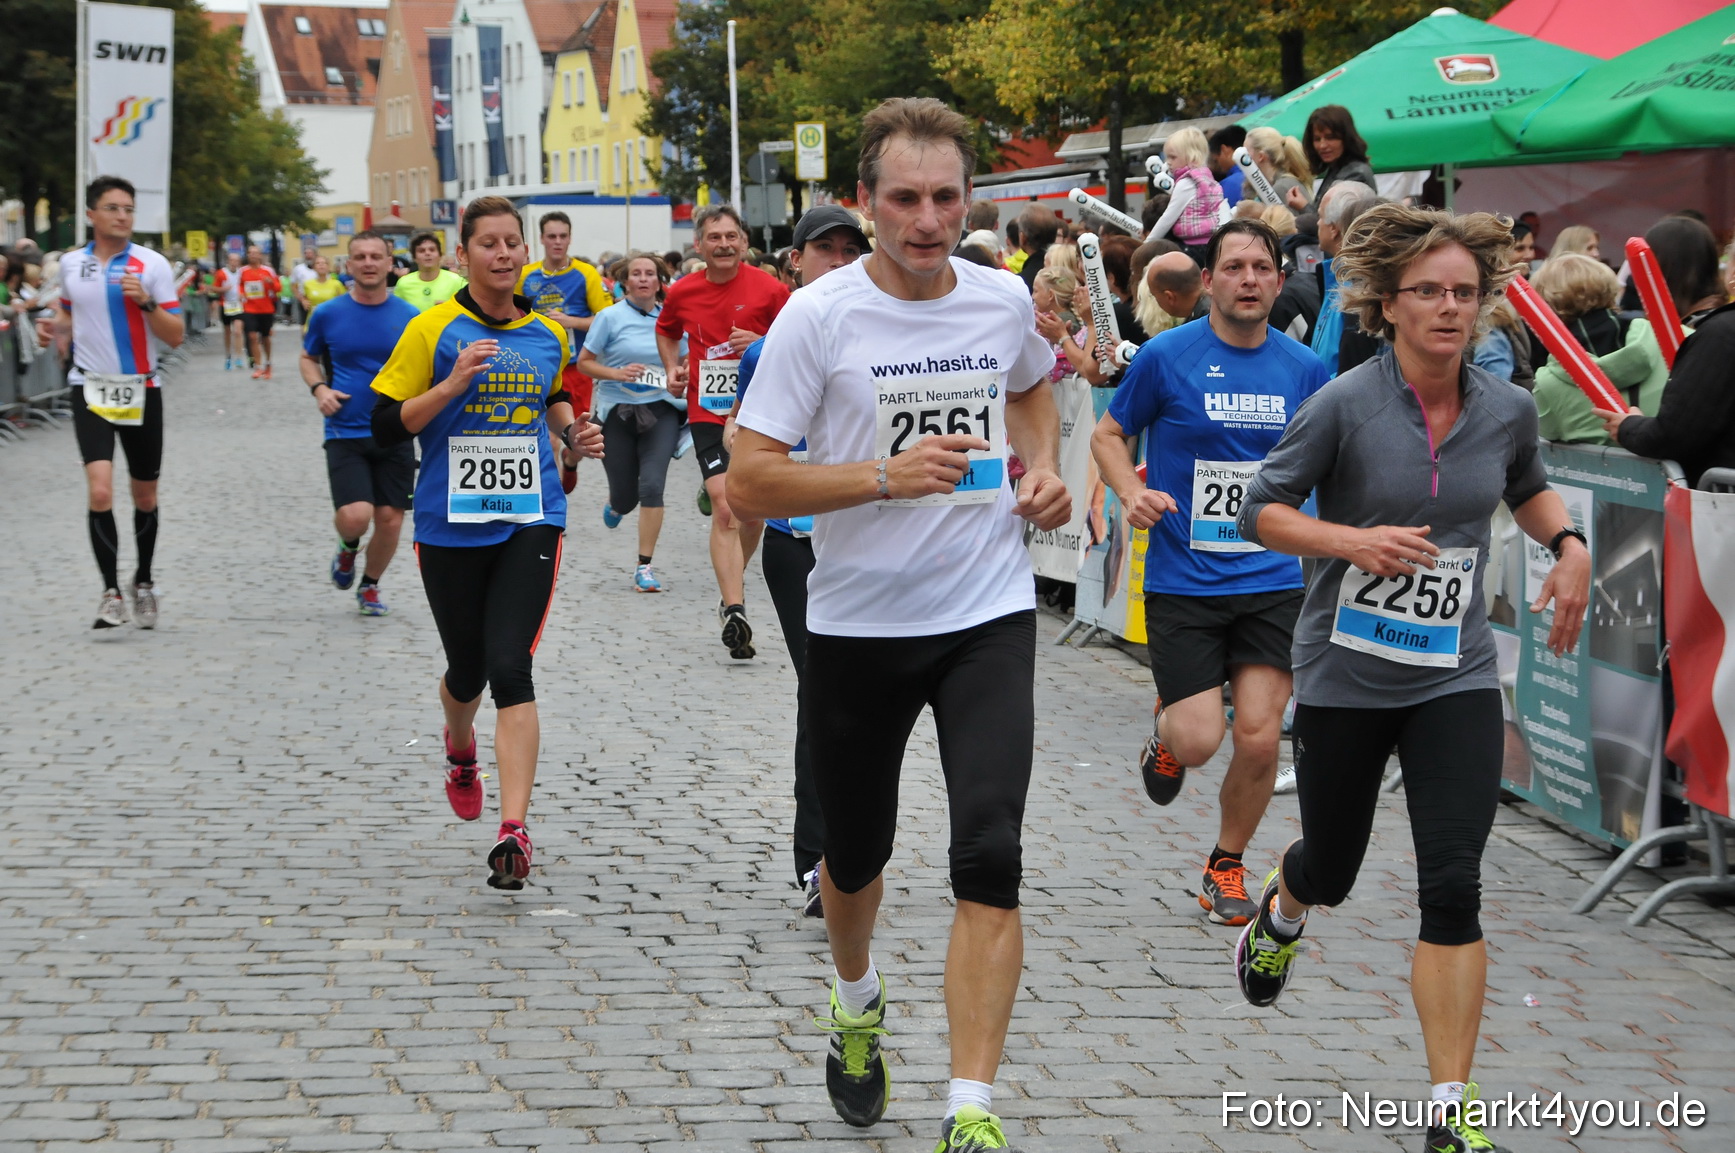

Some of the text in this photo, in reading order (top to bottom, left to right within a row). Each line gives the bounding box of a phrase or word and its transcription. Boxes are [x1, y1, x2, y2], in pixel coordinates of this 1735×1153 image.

[94, 41, 167, 64] swn
[1091, 203, 1141, 235] bmw-laufspor
[1088, 267, 1113, 346] bmw-laufspo
[871, 354, 998, 377] www.hasit.de
[705, 374, 738, 393] 223
[98, 387, 134, 405] 149
[879, 387, 985, 405] PARTL Neumarkt
[1204, 393, 1286, 413] HUBER
[1223, 412, 1283, 422] TECHNOLOGY
[890, 405, 990, 457] 2561
[485, 446, 526, 454] Neumarkt
[460, 458, 533, 490] 2859
[1197, 469, 1229, 479] PARTL
[481, 499, 512, 513] Katja
[1203, 483, 1243, 517] 28
[1354, 571, 1461, 620] 2258
[1374, 621, 1429, 648] Korina
